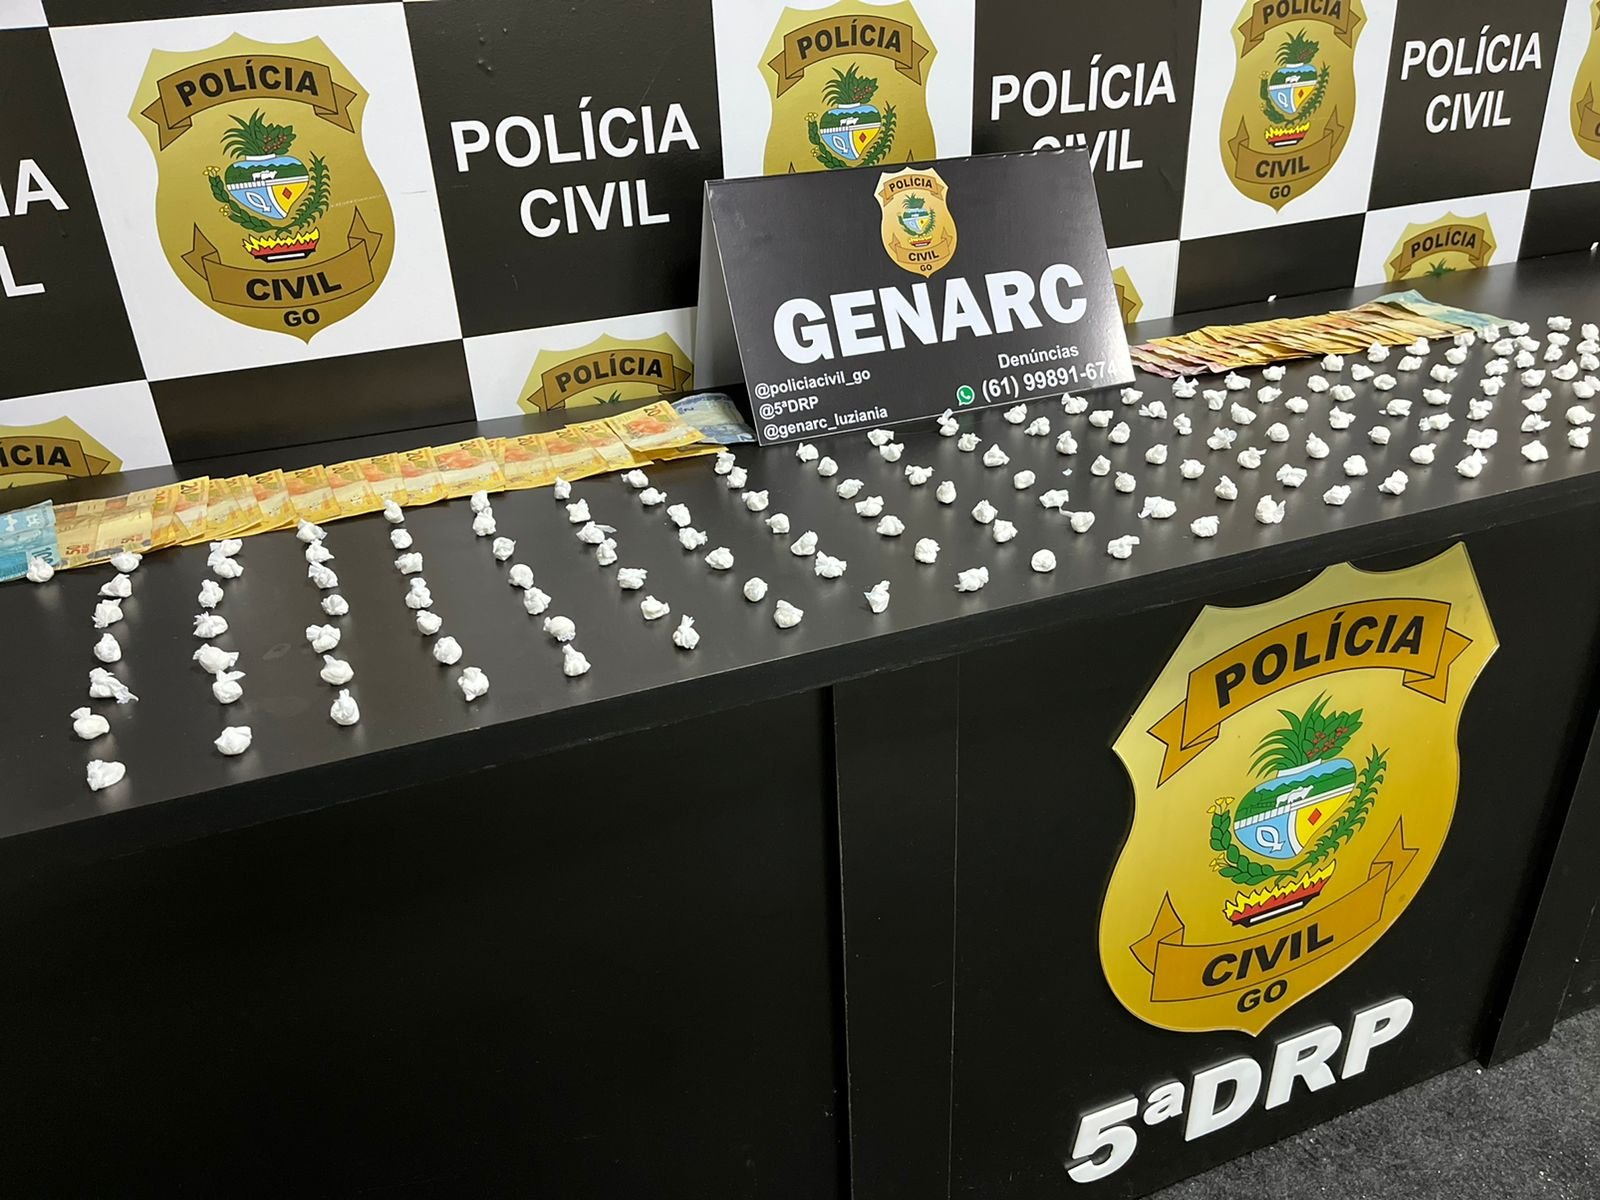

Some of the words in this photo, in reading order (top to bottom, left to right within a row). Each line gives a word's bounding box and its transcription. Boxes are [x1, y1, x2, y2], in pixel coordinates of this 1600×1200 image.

[797, 18, 901, 60] POLÍCIA
[1400, 25, 1542, 81] POLÍCIA
[175, 60, 319, 107] POLÍCIA
[990, 54, 1177, 121] POLÍCIA
[1425, 90, 1512, 134] CIVIL
[450, 96, 700, 173] POLÍCIA
[888, 175, 933, 193] POLÍCIA
[1255, 156, 1311, 179] CIVIL
[519, 179, 671, 238] CIVIL
[1269, 184, 1291, 200] GO
[908, 250, 940, 262] CIVIL
[1411, 227, 1476, 258] POLÍCIA
[246, 271, 343, 302] CIVIL
[283, 308, 321, 328] GO
[773, 263, 1088, 365] GENARC
[555, 353, 663, 393] POLÍCIA
[997, 344, 1080, 369] Denúncias
[754, 369, 872, 400] @policiacivil_go
[982, 375, 1020, 403] (61)
[763, 406, 889, 441] @genarc_luziania
[1215, 611, 1425, 709] POLÍCIA
[1202, 922, 1334, 987] CIVIL
[1237, 979, 1288, 1013] GO
